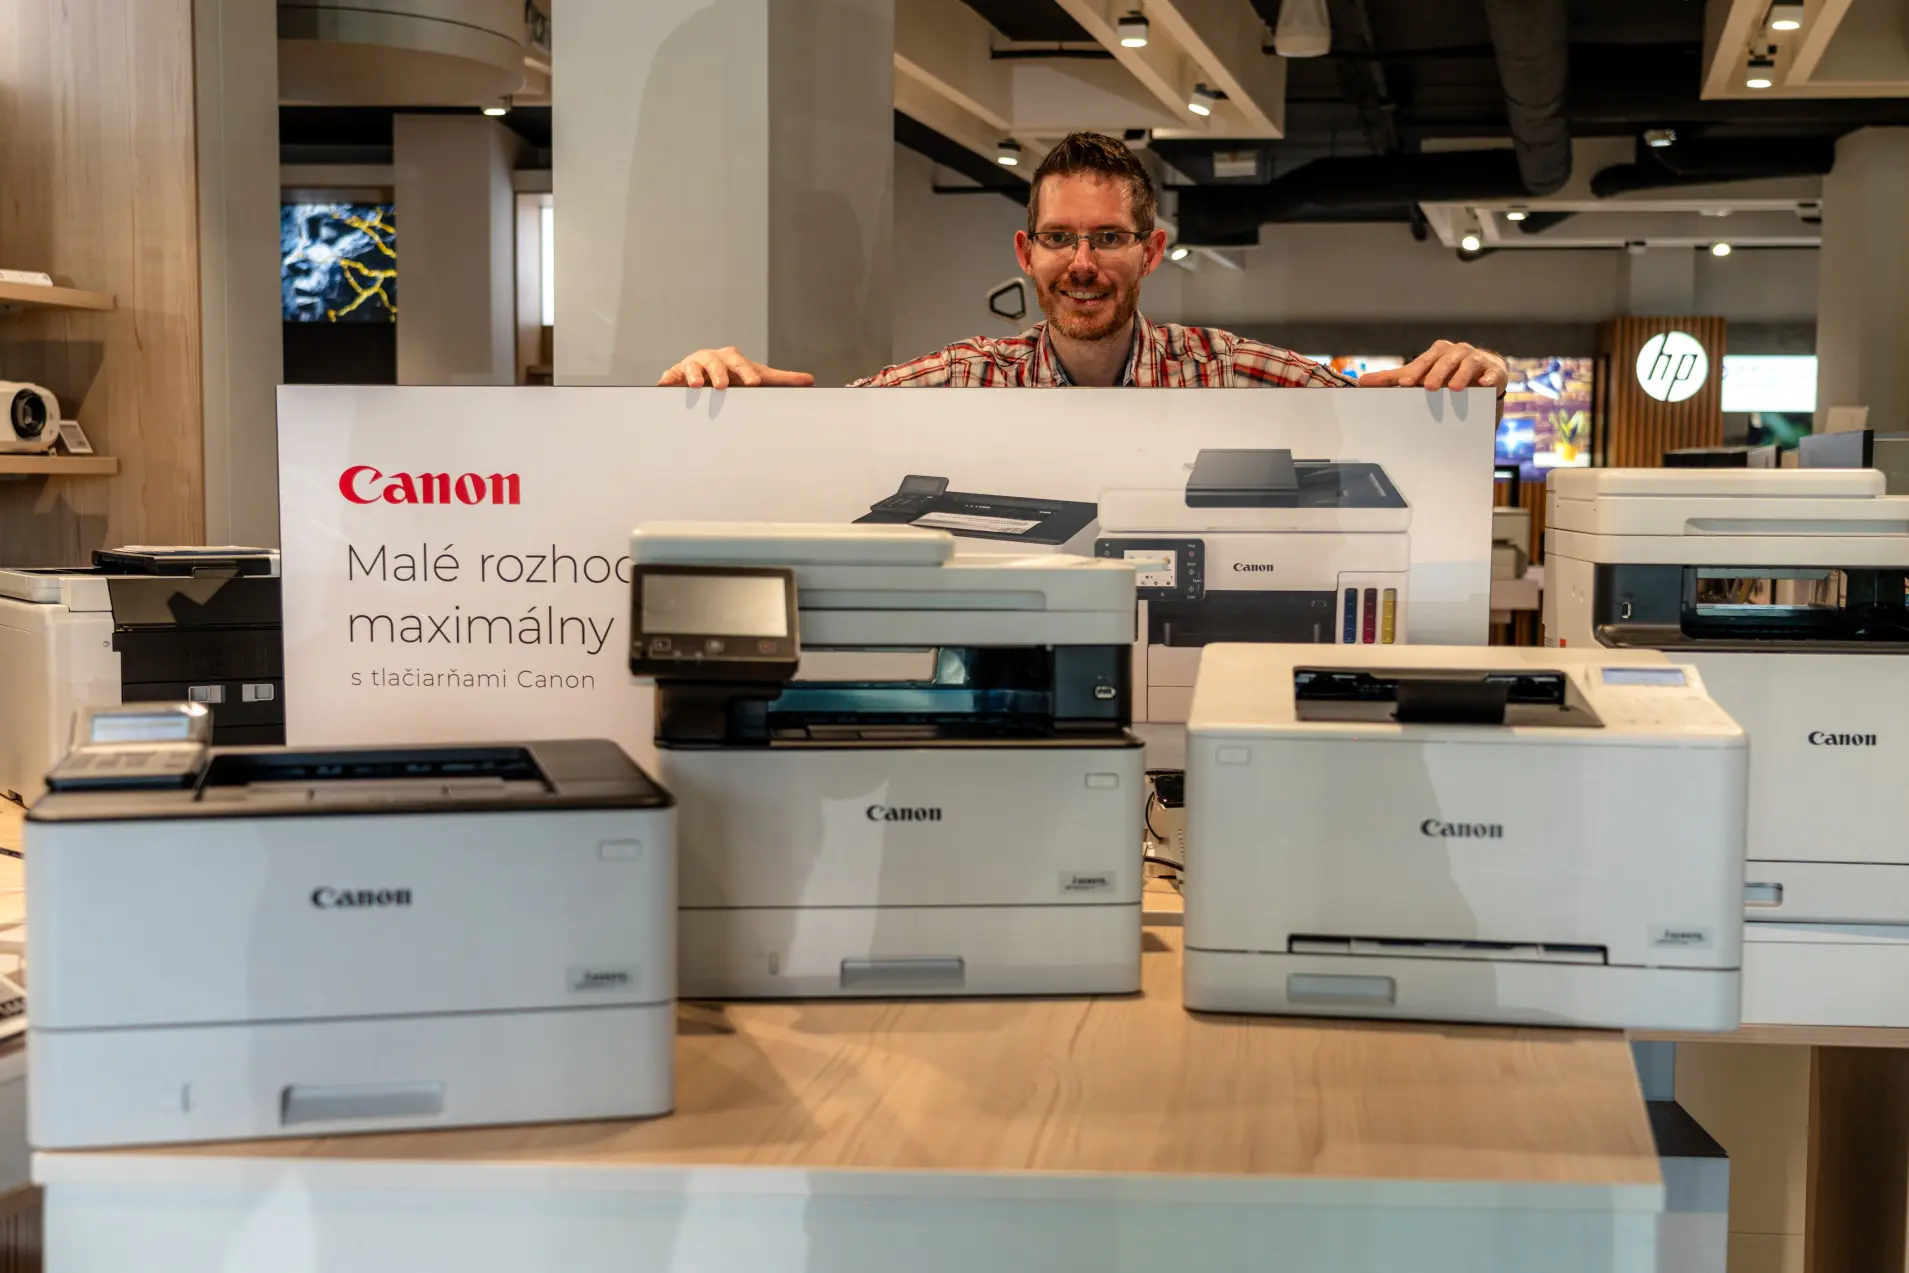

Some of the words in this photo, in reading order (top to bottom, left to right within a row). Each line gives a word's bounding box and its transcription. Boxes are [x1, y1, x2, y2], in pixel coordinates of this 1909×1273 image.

[1646, 332, 1699, 402] hp
[338, 465, 521, 506] Canon
[349, 542, 460, 583] Malé
[1233, 562, 1274, 573] Canon
[349, 605, 615, 655] maximálny
[351, 672, 362, 687] s
[371, 667, 507, 688] tlačiarňami
[517, 669, 595, 689] Canon
[1807, 730, 1877, 748] Canon
[866, 804, 942, 823] Canon
[1419, 818, 1503, 839] Canon
[310, 887, 412, 909] Canon
